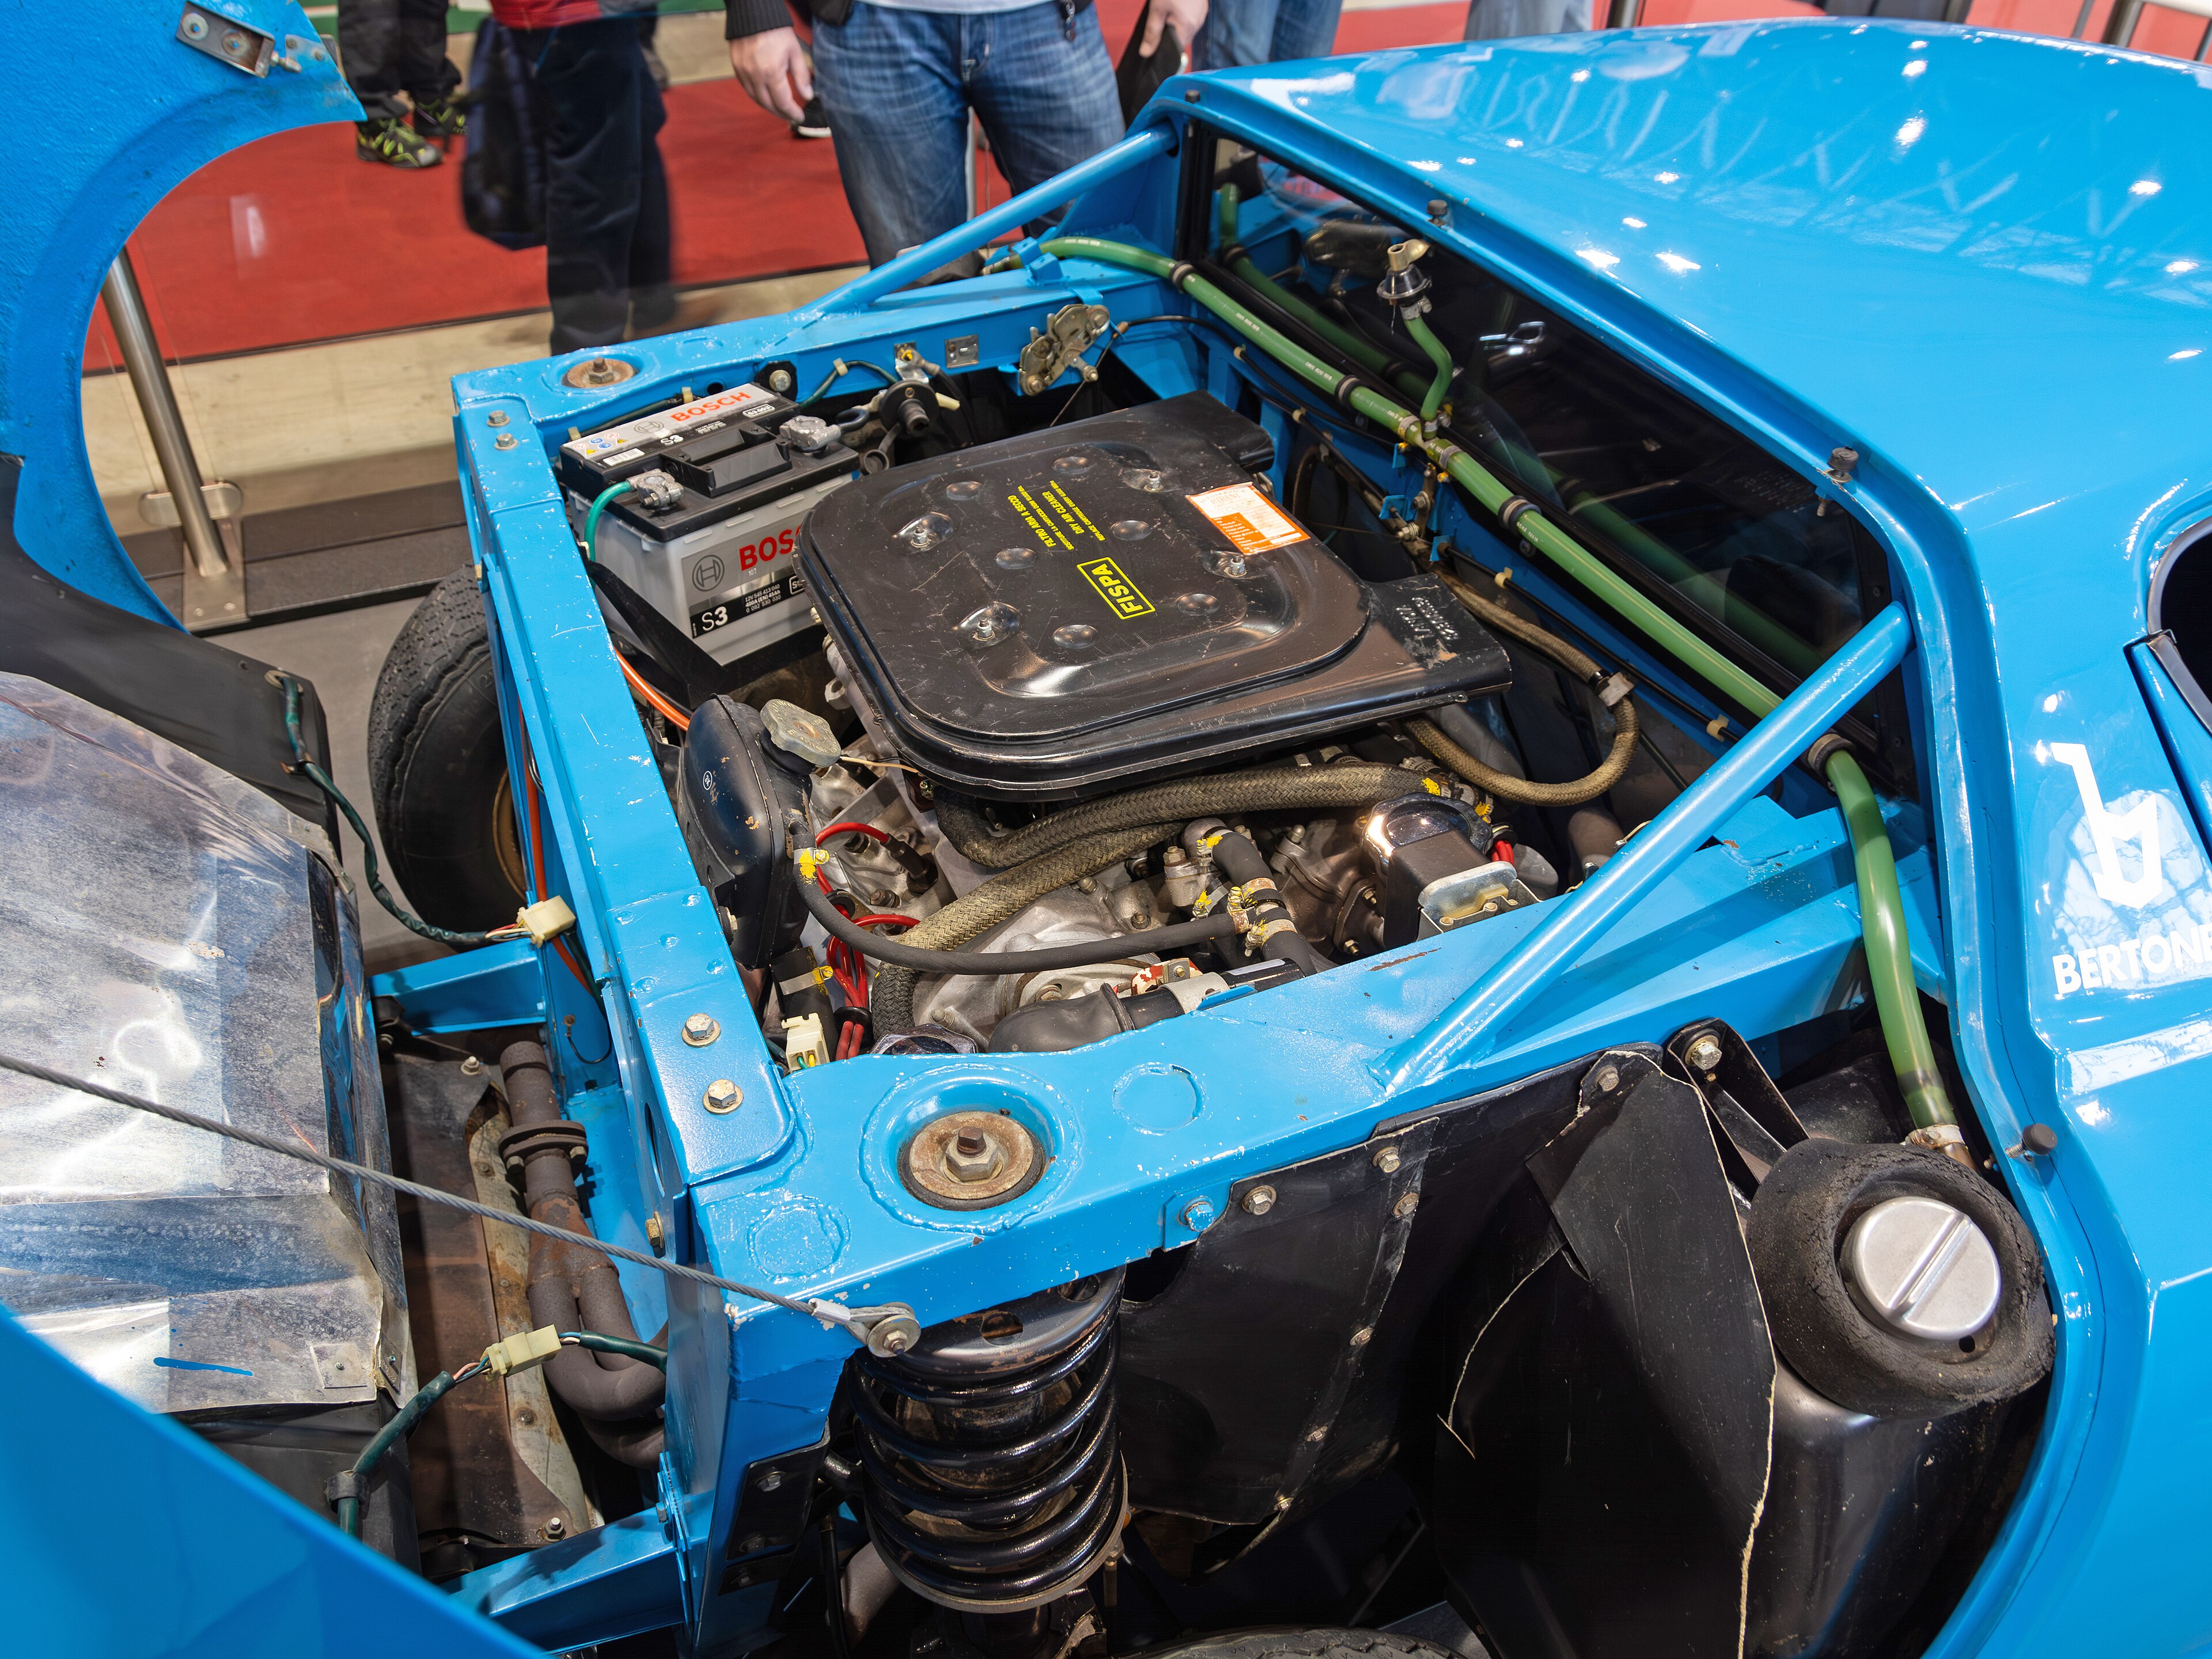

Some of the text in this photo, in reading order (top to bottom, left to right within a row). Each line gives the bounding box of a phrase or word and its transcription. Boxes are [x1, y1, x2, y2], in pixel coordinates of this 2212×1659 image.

[670, 391, 752, 422] BOSCH
[660, 434, 684, 446] S3
[1007, 495, 1027, 512] SECCO
[1063, 497, 1076, 507] EVERY
[1042, 491, 1085, 535] DRY AIR CLEANER
[1072, 506, 1092, 525] CARTRIDGE
[1025, 516, 1041, 529] ARIA
[1035, 528, 1056, 548] FILTRO
[1088, 525, 1105, 541] REPLACE
[739, 525, 801, 571] BOS
[763, 587, 771, 595] 413
[1091, 563, 1143, 613] FISPA
[745, 590, 781, 607] 400A (EN) 45Ah
[702, 606, 729, 631] S3
